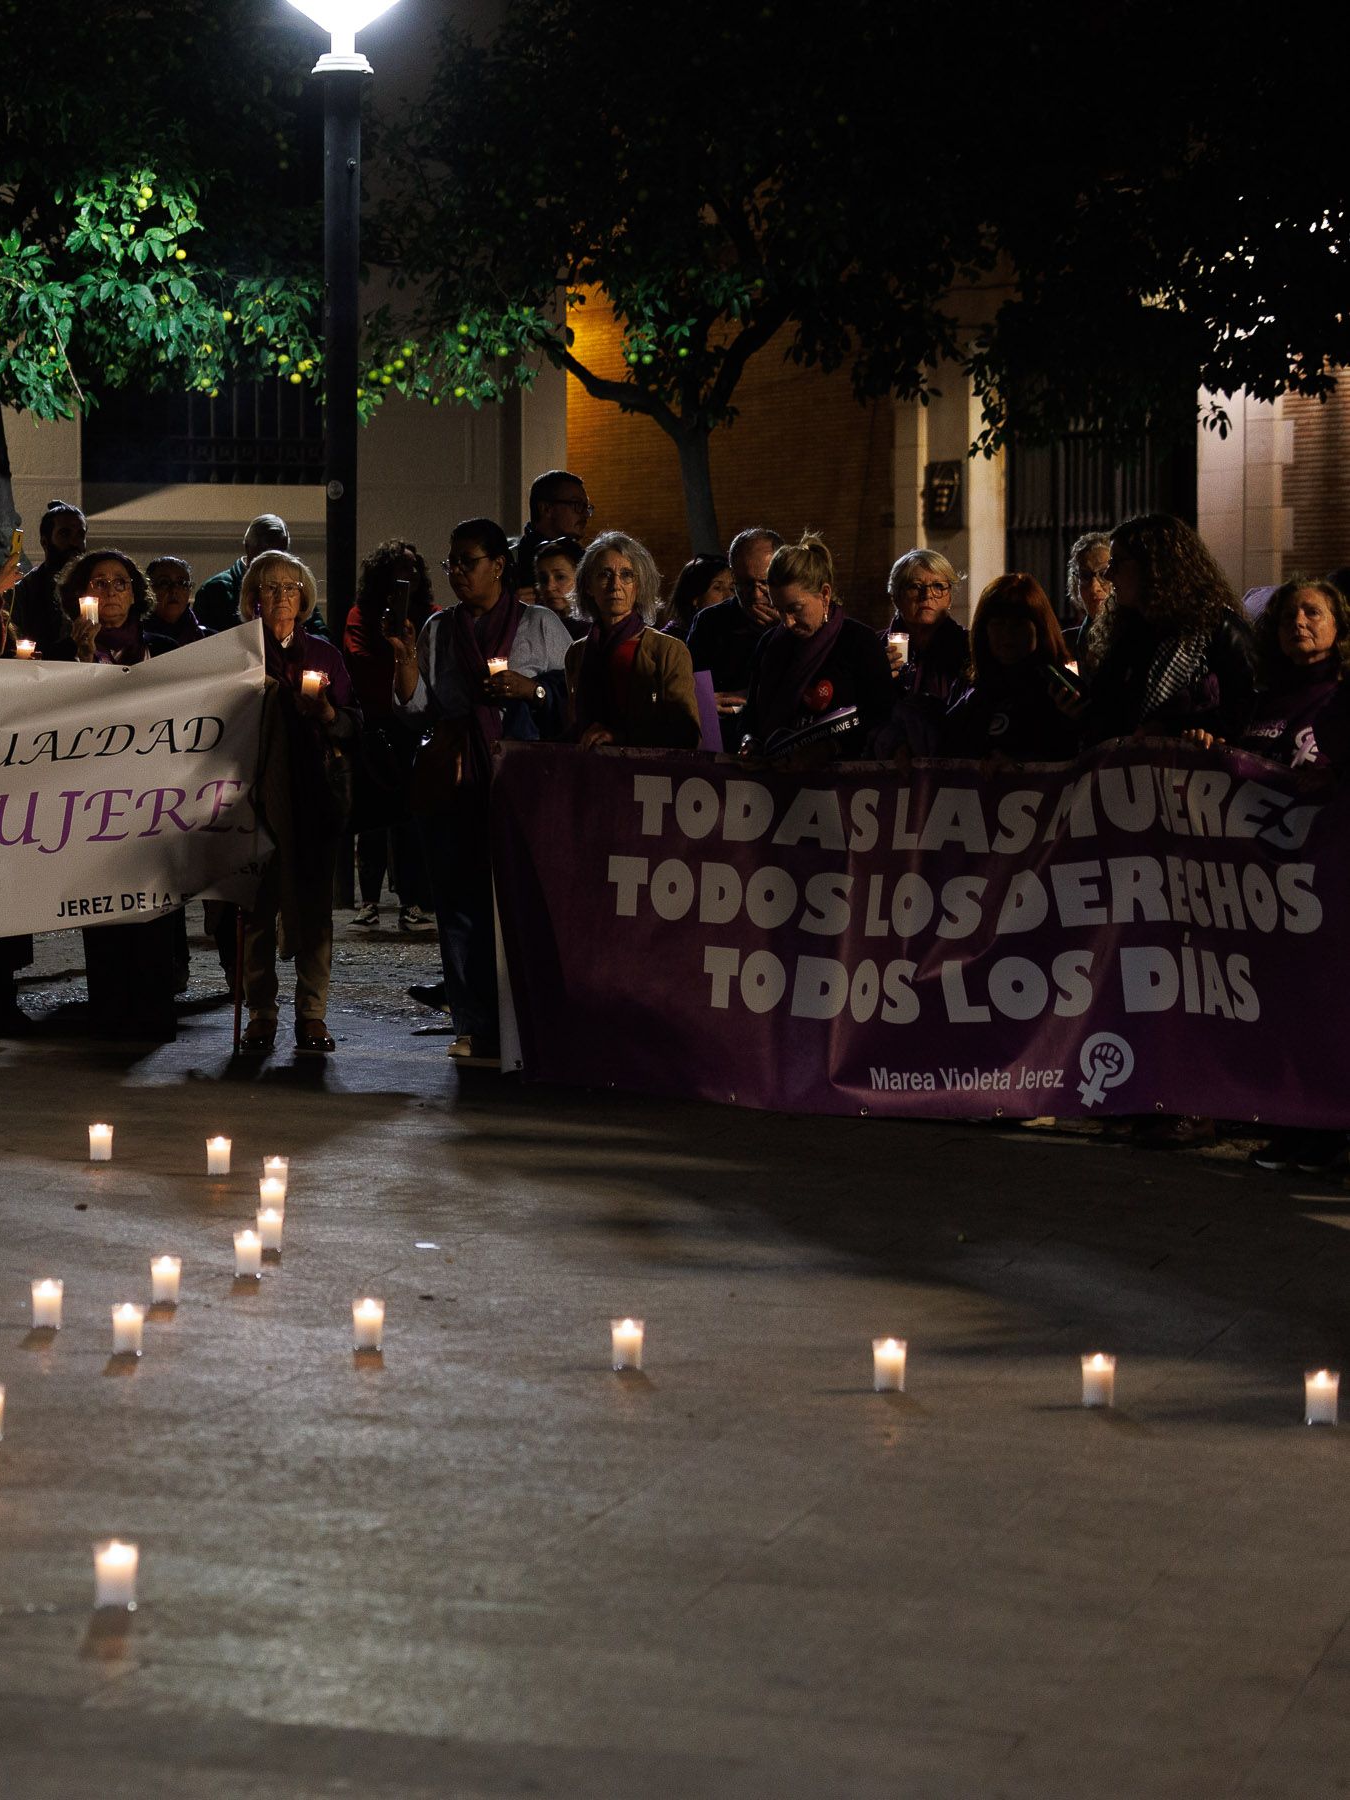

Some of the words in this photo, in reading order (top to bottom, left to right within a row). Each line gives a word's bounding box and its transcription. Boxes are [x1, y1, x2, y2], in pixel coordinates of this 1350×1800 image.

[634, 775, 879, 851] TODAS
[892, 788, 1042, 853] LAS
[57, 896, 113, 917] JEREZ
[121, 893, 146, 910] DE
[153, 892, 173, 909] LA
[608, 855, 854, 935] TODOS
[865, 873, 987, 938] LOS
[996, 857, 1323, 934] DERECHOS
[703, 946, 921, 1024] TODOS
[941, 950, 1096, 1023] LOS
[1121, 932, 1260, 1022] DÍAS
[870, 1067, 935, 1090] Marea
[939, 1067, 1011, 1090] Violeta
[1015, 1066, 1064, 1090] Jerez
